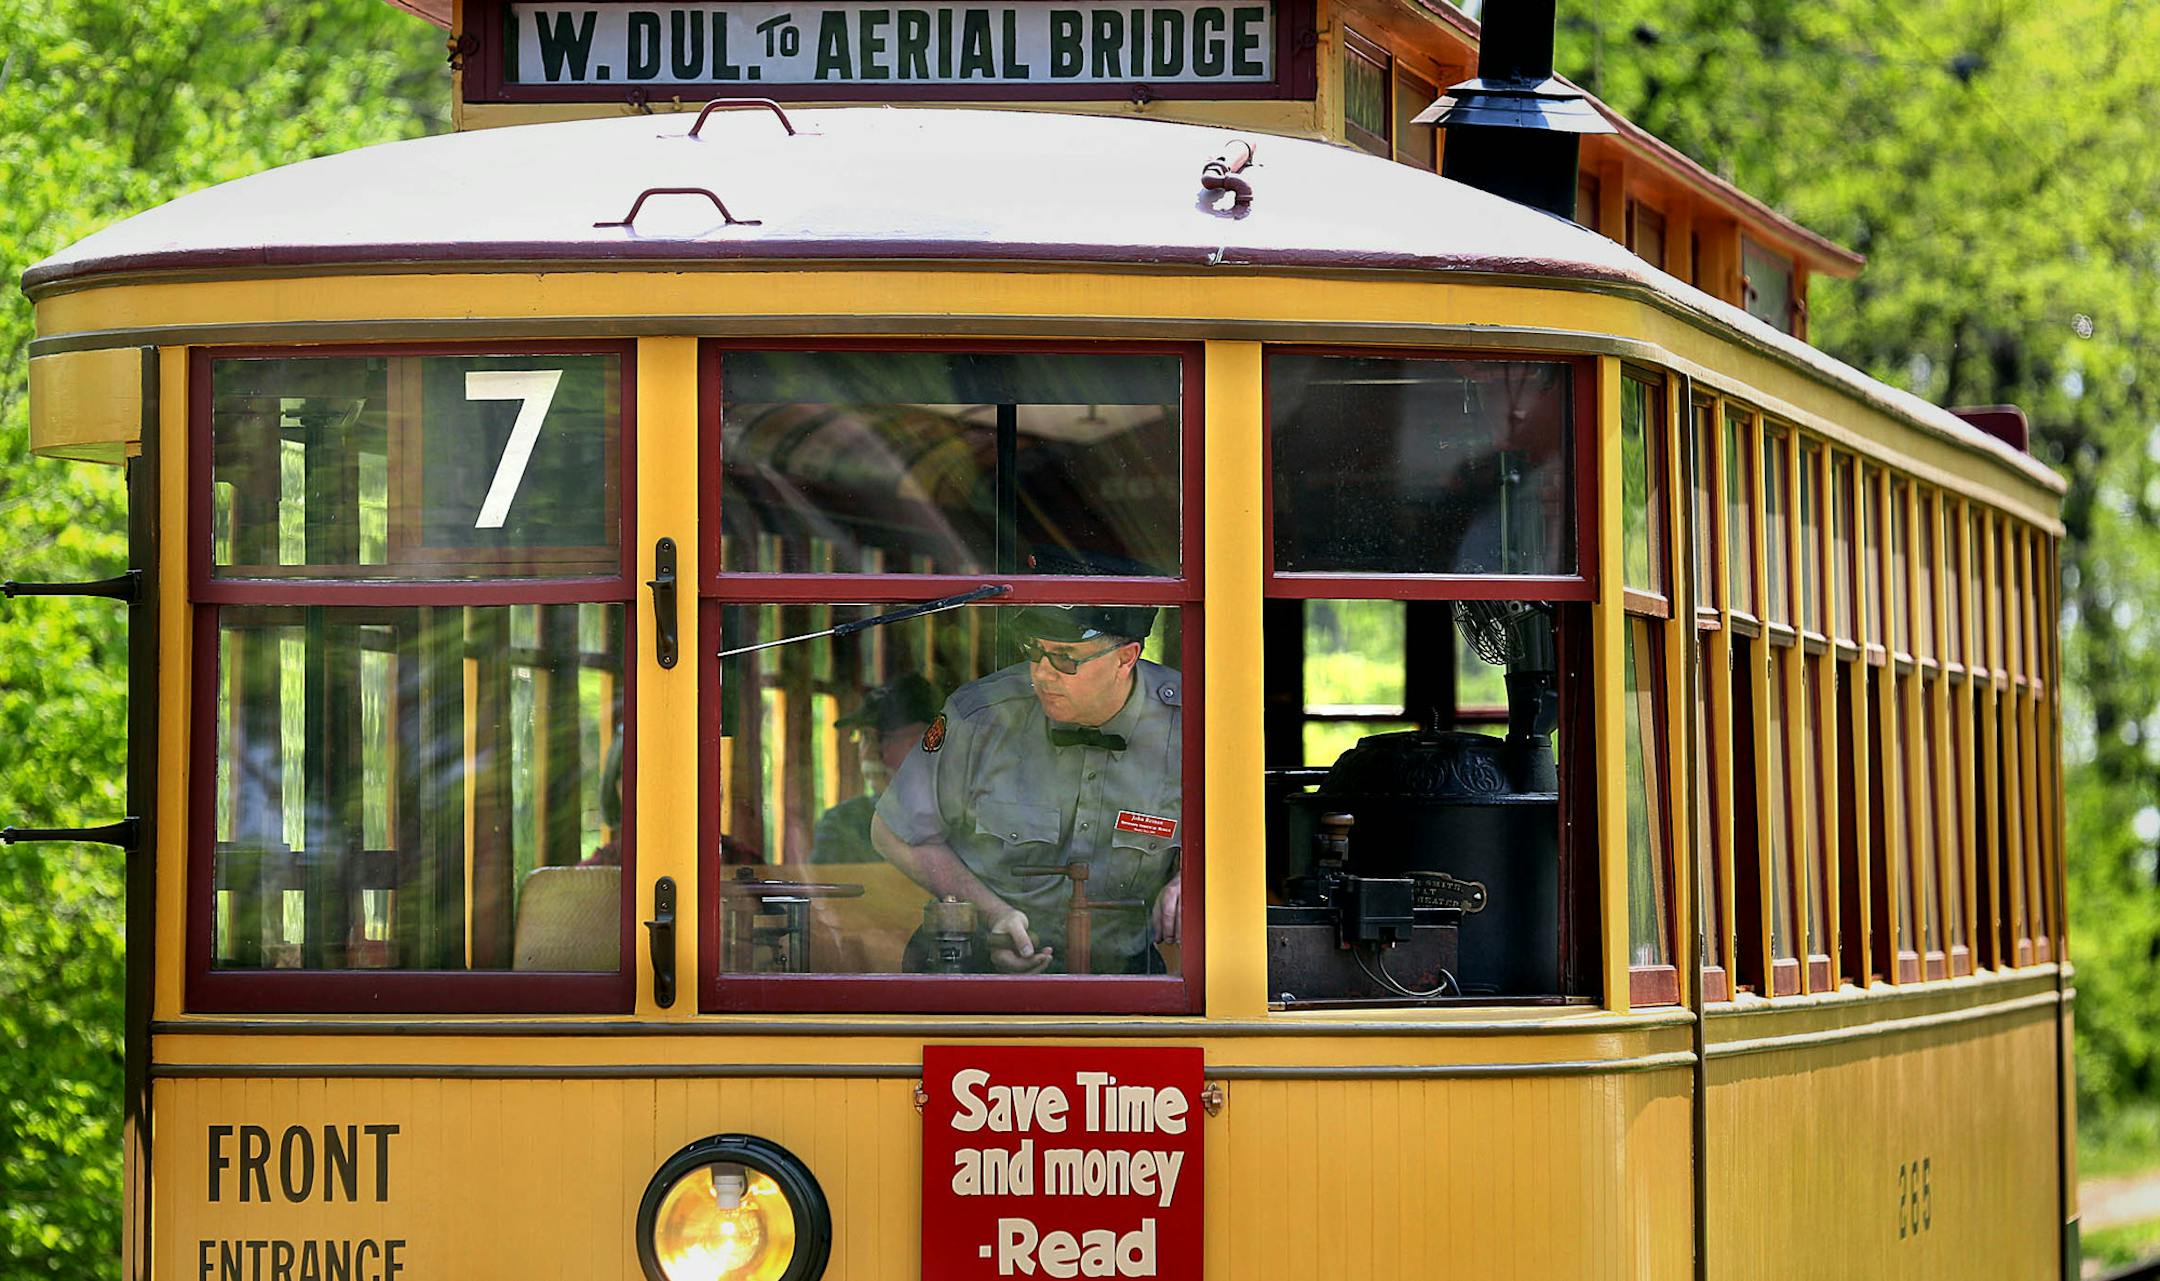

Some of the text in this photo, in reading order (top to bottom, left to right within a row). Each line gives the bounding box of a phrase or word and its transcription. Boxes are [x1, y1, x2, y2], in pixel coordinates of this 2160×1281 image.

[535, 11, 610, 81] W.
[627, 10, 761, 80] DUL.
[814, 9, 1029, 80] AERIAL
[1050, 7, 1264, 78] BRIDGE
[465, 369, 563, 528] 7
[951, 1069, 1189, 1134] Save Time
[208, 1124, 400, 1203] FRONT
[951, 1139, 1184, 1207] and money
[1899, 1157, 1931, 1240] 265
[199, 1239, 406, 1281] ENTRANCE
